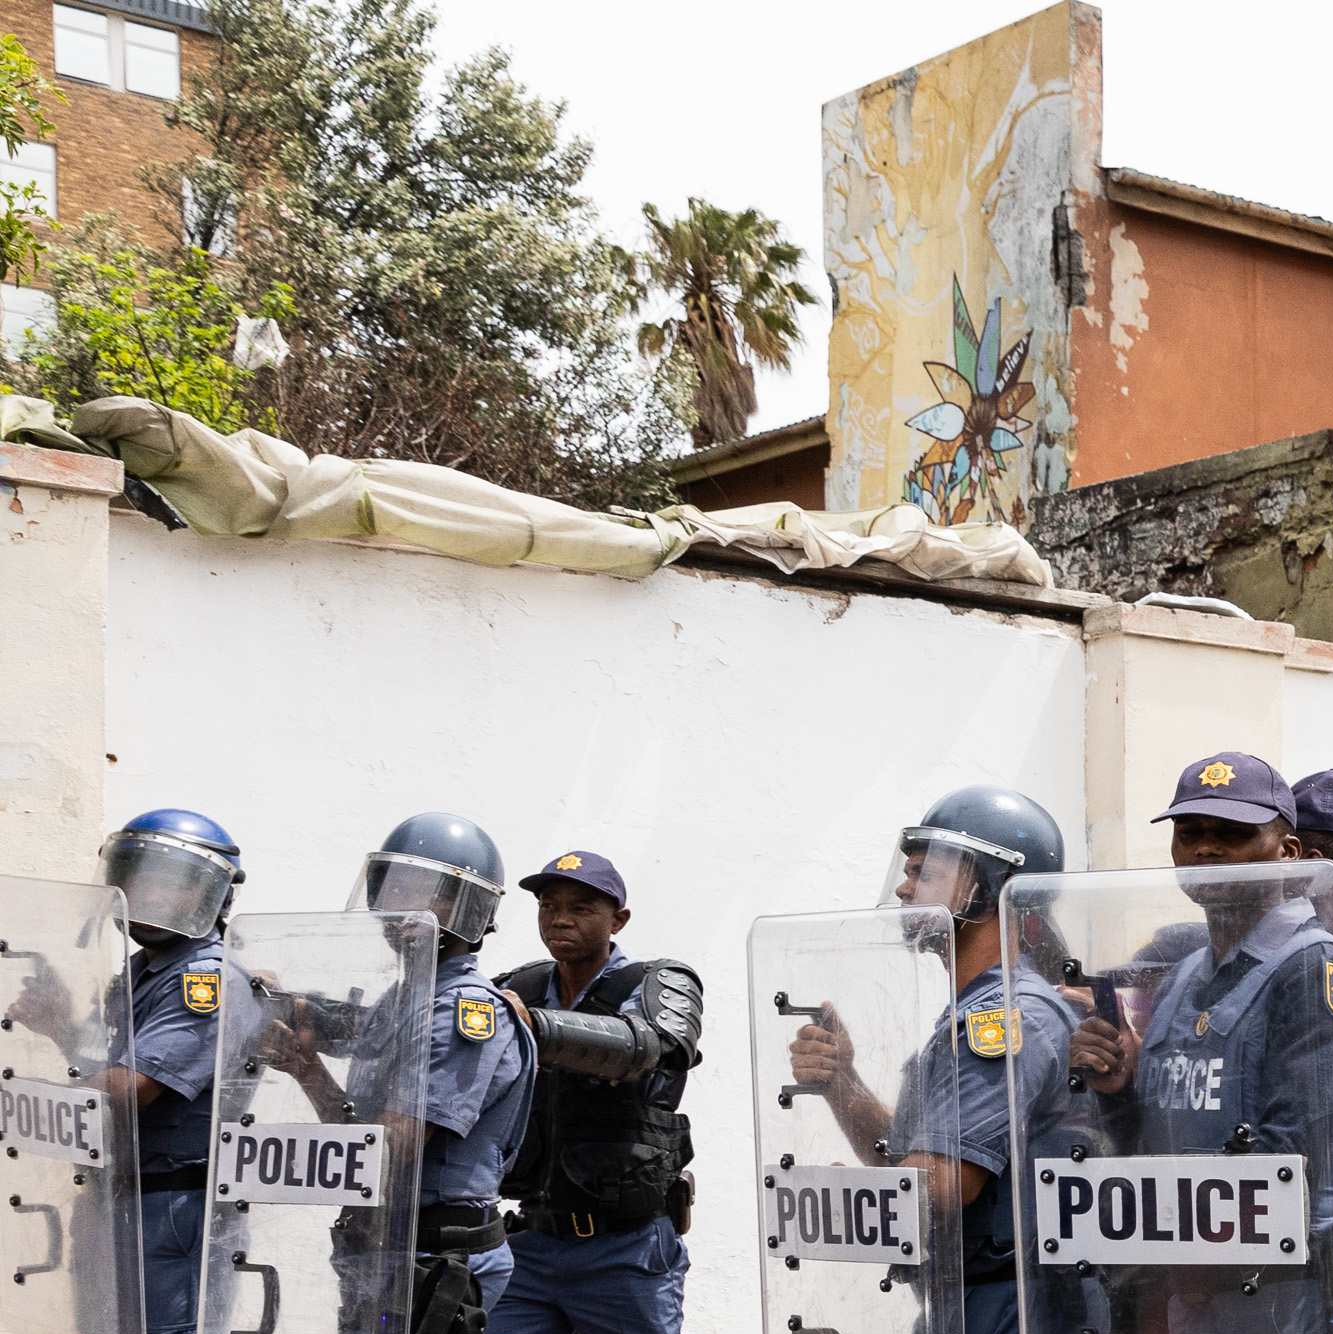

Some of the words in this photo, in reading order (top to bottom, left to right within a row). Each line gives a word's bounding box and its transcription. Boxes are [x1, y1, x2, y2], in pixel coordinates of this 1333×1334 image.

[186, 975, 217, 984] POLICE
[461, 1001, 492, 1014] POLICE
[971, 1012, 1005, 1025] POLICE
[1, 1089, 89, 1150] POLICE
[235, 1135, 366, 1190] POLICE
[776, 1187, 900, 1247] POLICE
[1058, 1176, 1270, 1244] POLICE
